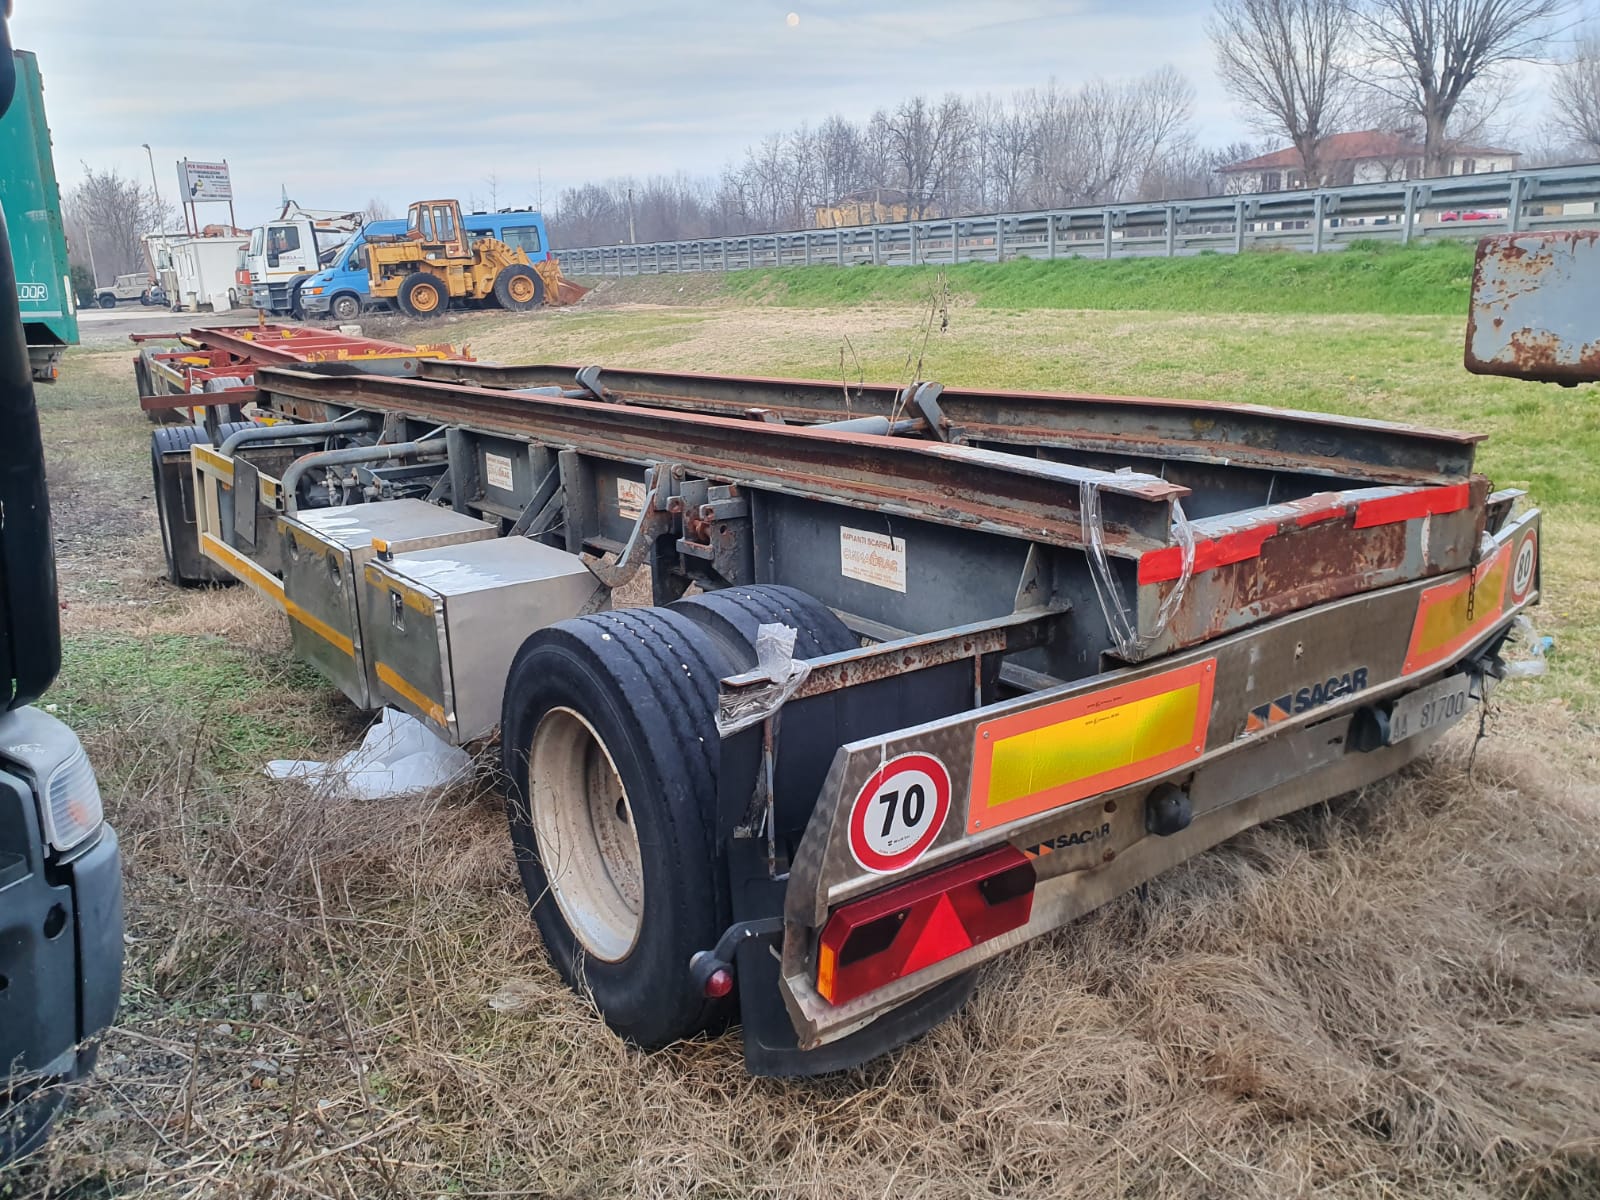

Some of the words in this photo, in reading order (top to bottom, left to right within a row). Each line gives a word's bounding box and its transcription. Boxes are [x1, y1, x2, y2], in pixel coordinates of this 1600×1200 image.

[18, 286, 45, 298] OOR
[842, 532, 867, 545] IMPIANTI
[867, 537, 903, 553] SCARRAILI
[1517, 549, 1531, 583] 80
[1420, 690, 1466, 728] 81700
[879, 783, 925, 838] 70
[1056, 822, 1110, 849] SACAR
